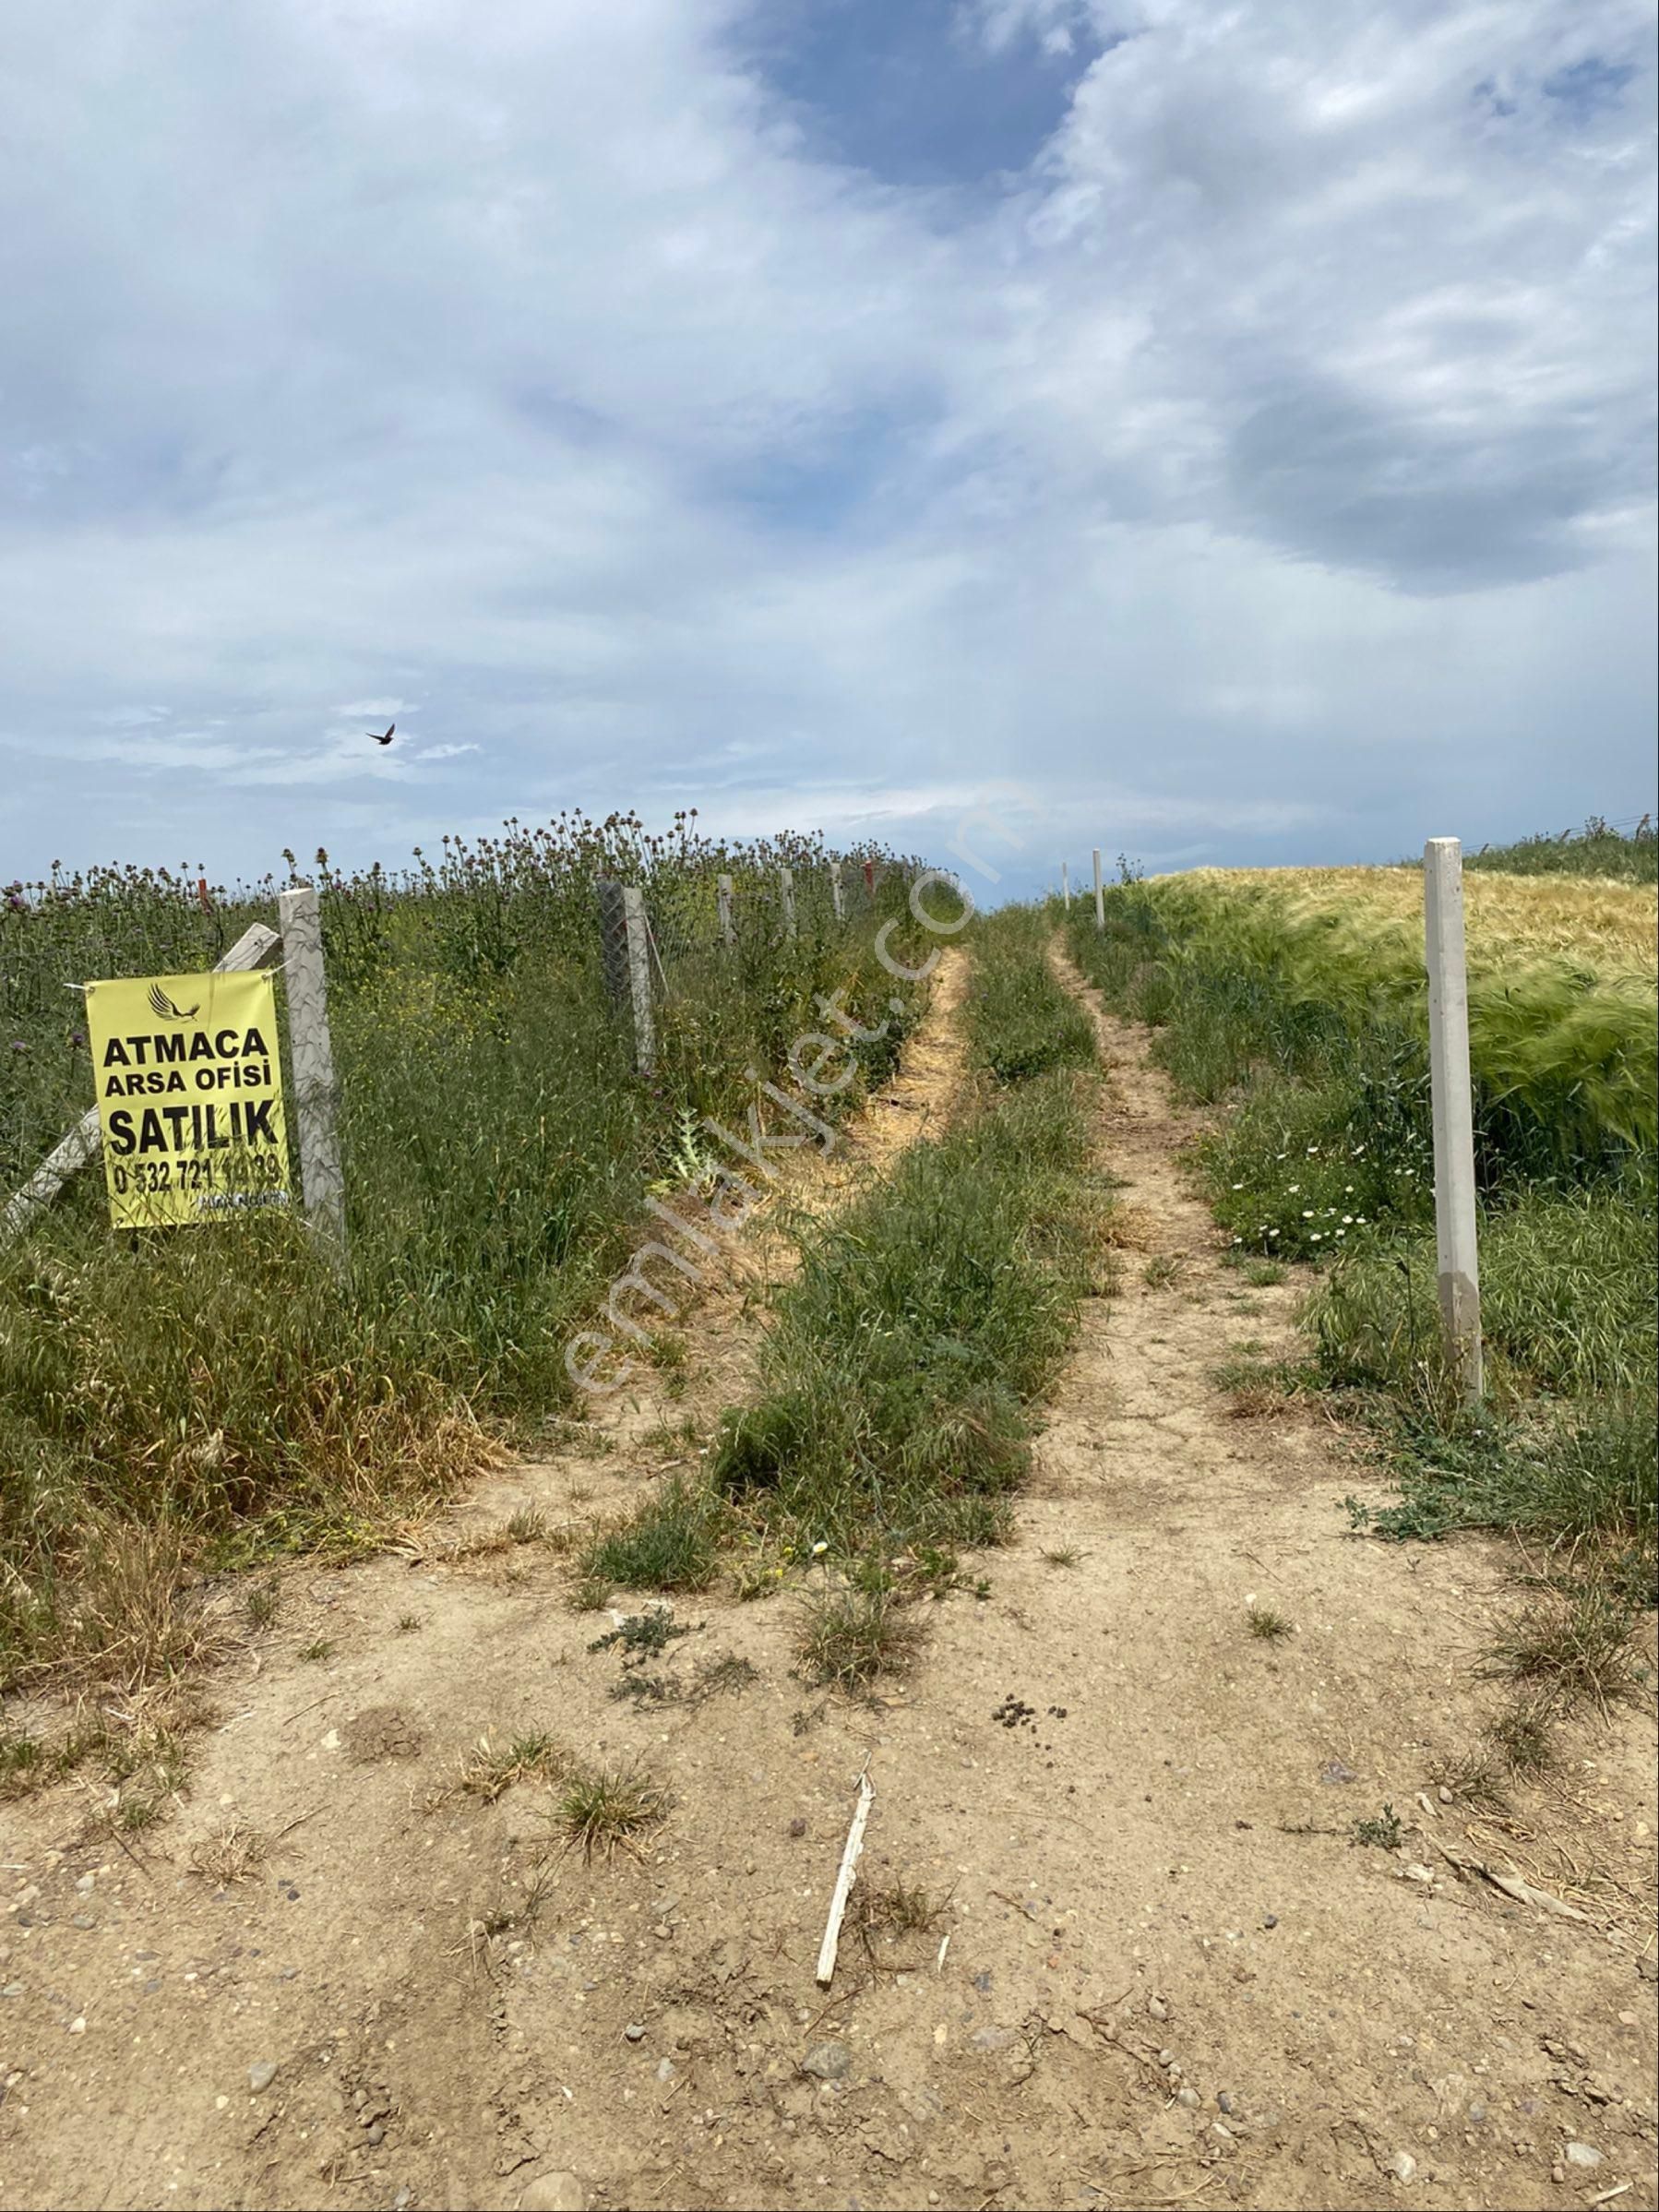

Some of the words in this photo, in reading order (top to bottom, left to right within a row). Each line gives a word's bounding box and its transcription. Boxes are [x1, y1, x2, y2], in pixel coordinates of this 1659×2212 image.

[103, 1027, 269, 1067] ATMACA
[105, 1070, 186, 1097] ARSA
[195, 1058, 272, 1090] OFİSİ
[109, 1099, 279, 1155] SATILIK
[114, 1165, 128, 1194] 0
[136, 1161, 171, 1193] 532
[176, 1158, 213, 1190] 721
